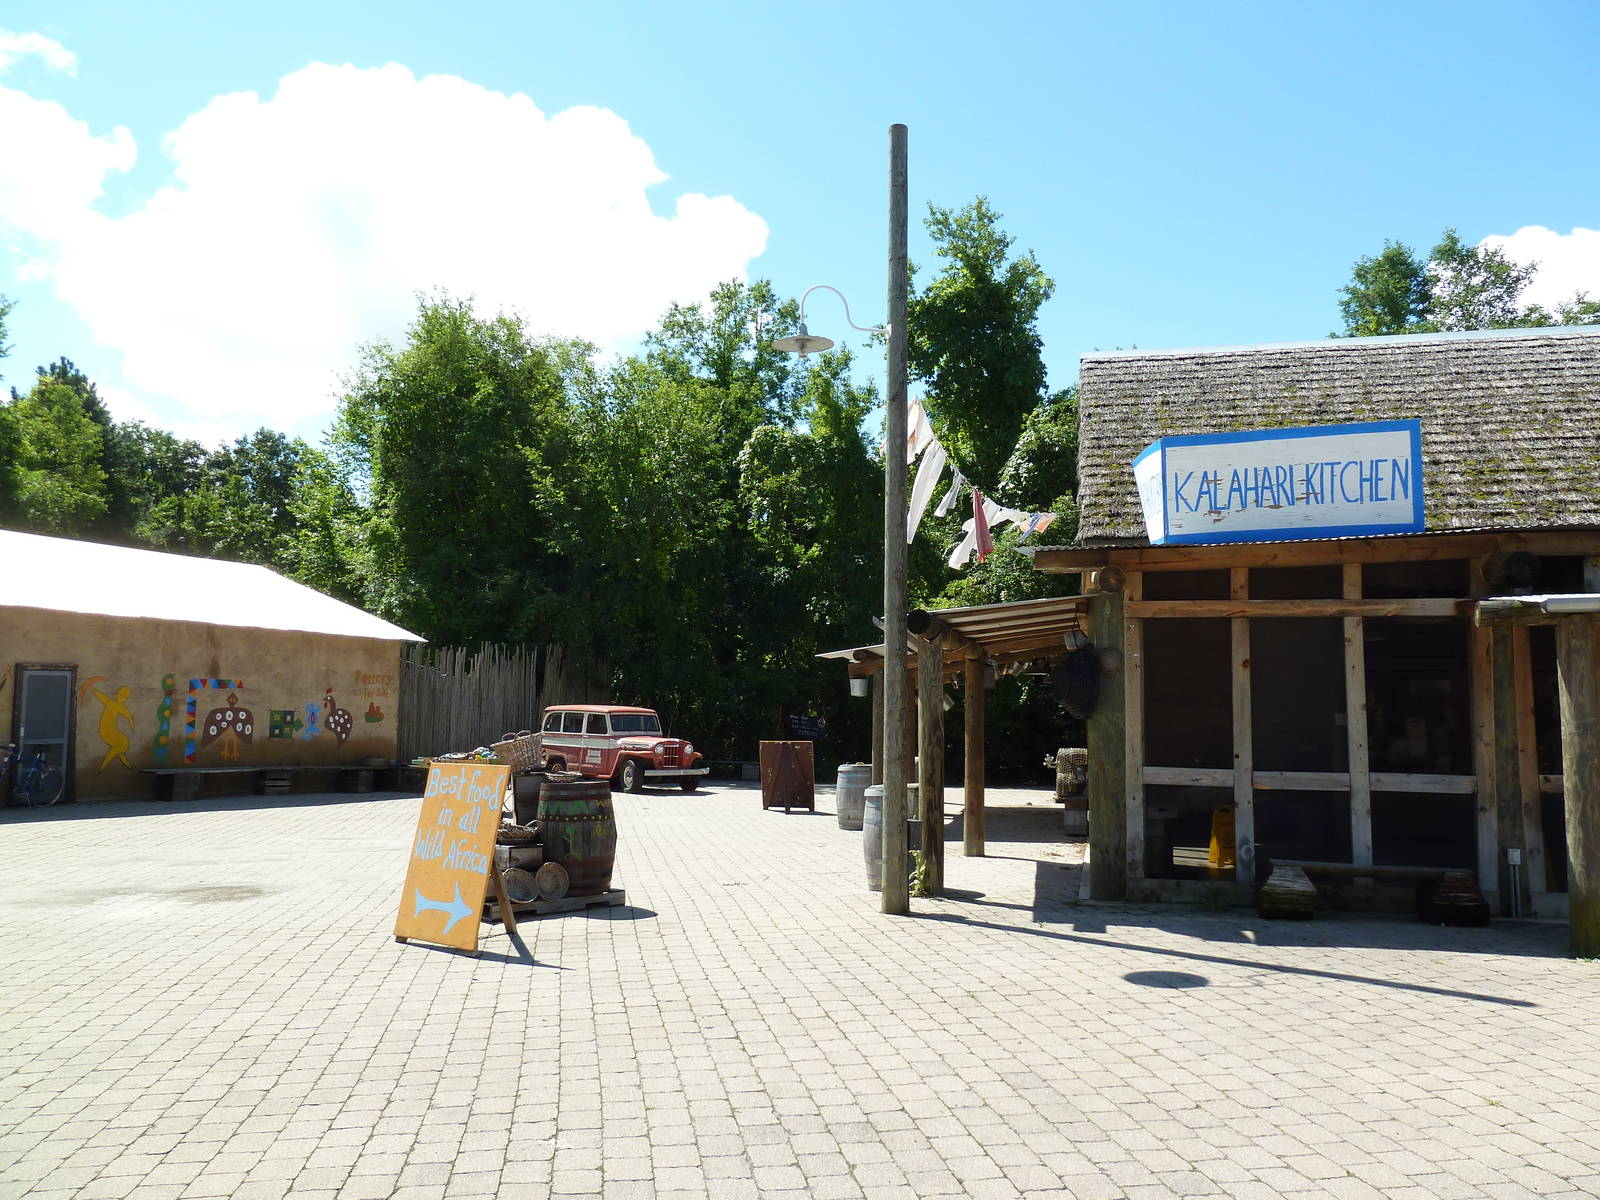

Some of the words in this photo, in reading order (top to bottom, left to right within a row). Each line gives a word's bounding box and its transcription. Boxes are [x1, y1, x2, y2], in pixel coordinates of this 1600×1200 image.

[1174, 464, 1295, 513] KALAHARI
[1305, 458, 1409, 505] KITCHEN
[425, 768, 466, 800] Best
[466, 770, 504, 810] food
[438, 802, 453, 827] in
[458, 806, 480, 833] all
[416, 828, 445, 859] Wild
[442, 839, 488, 874] Africa
